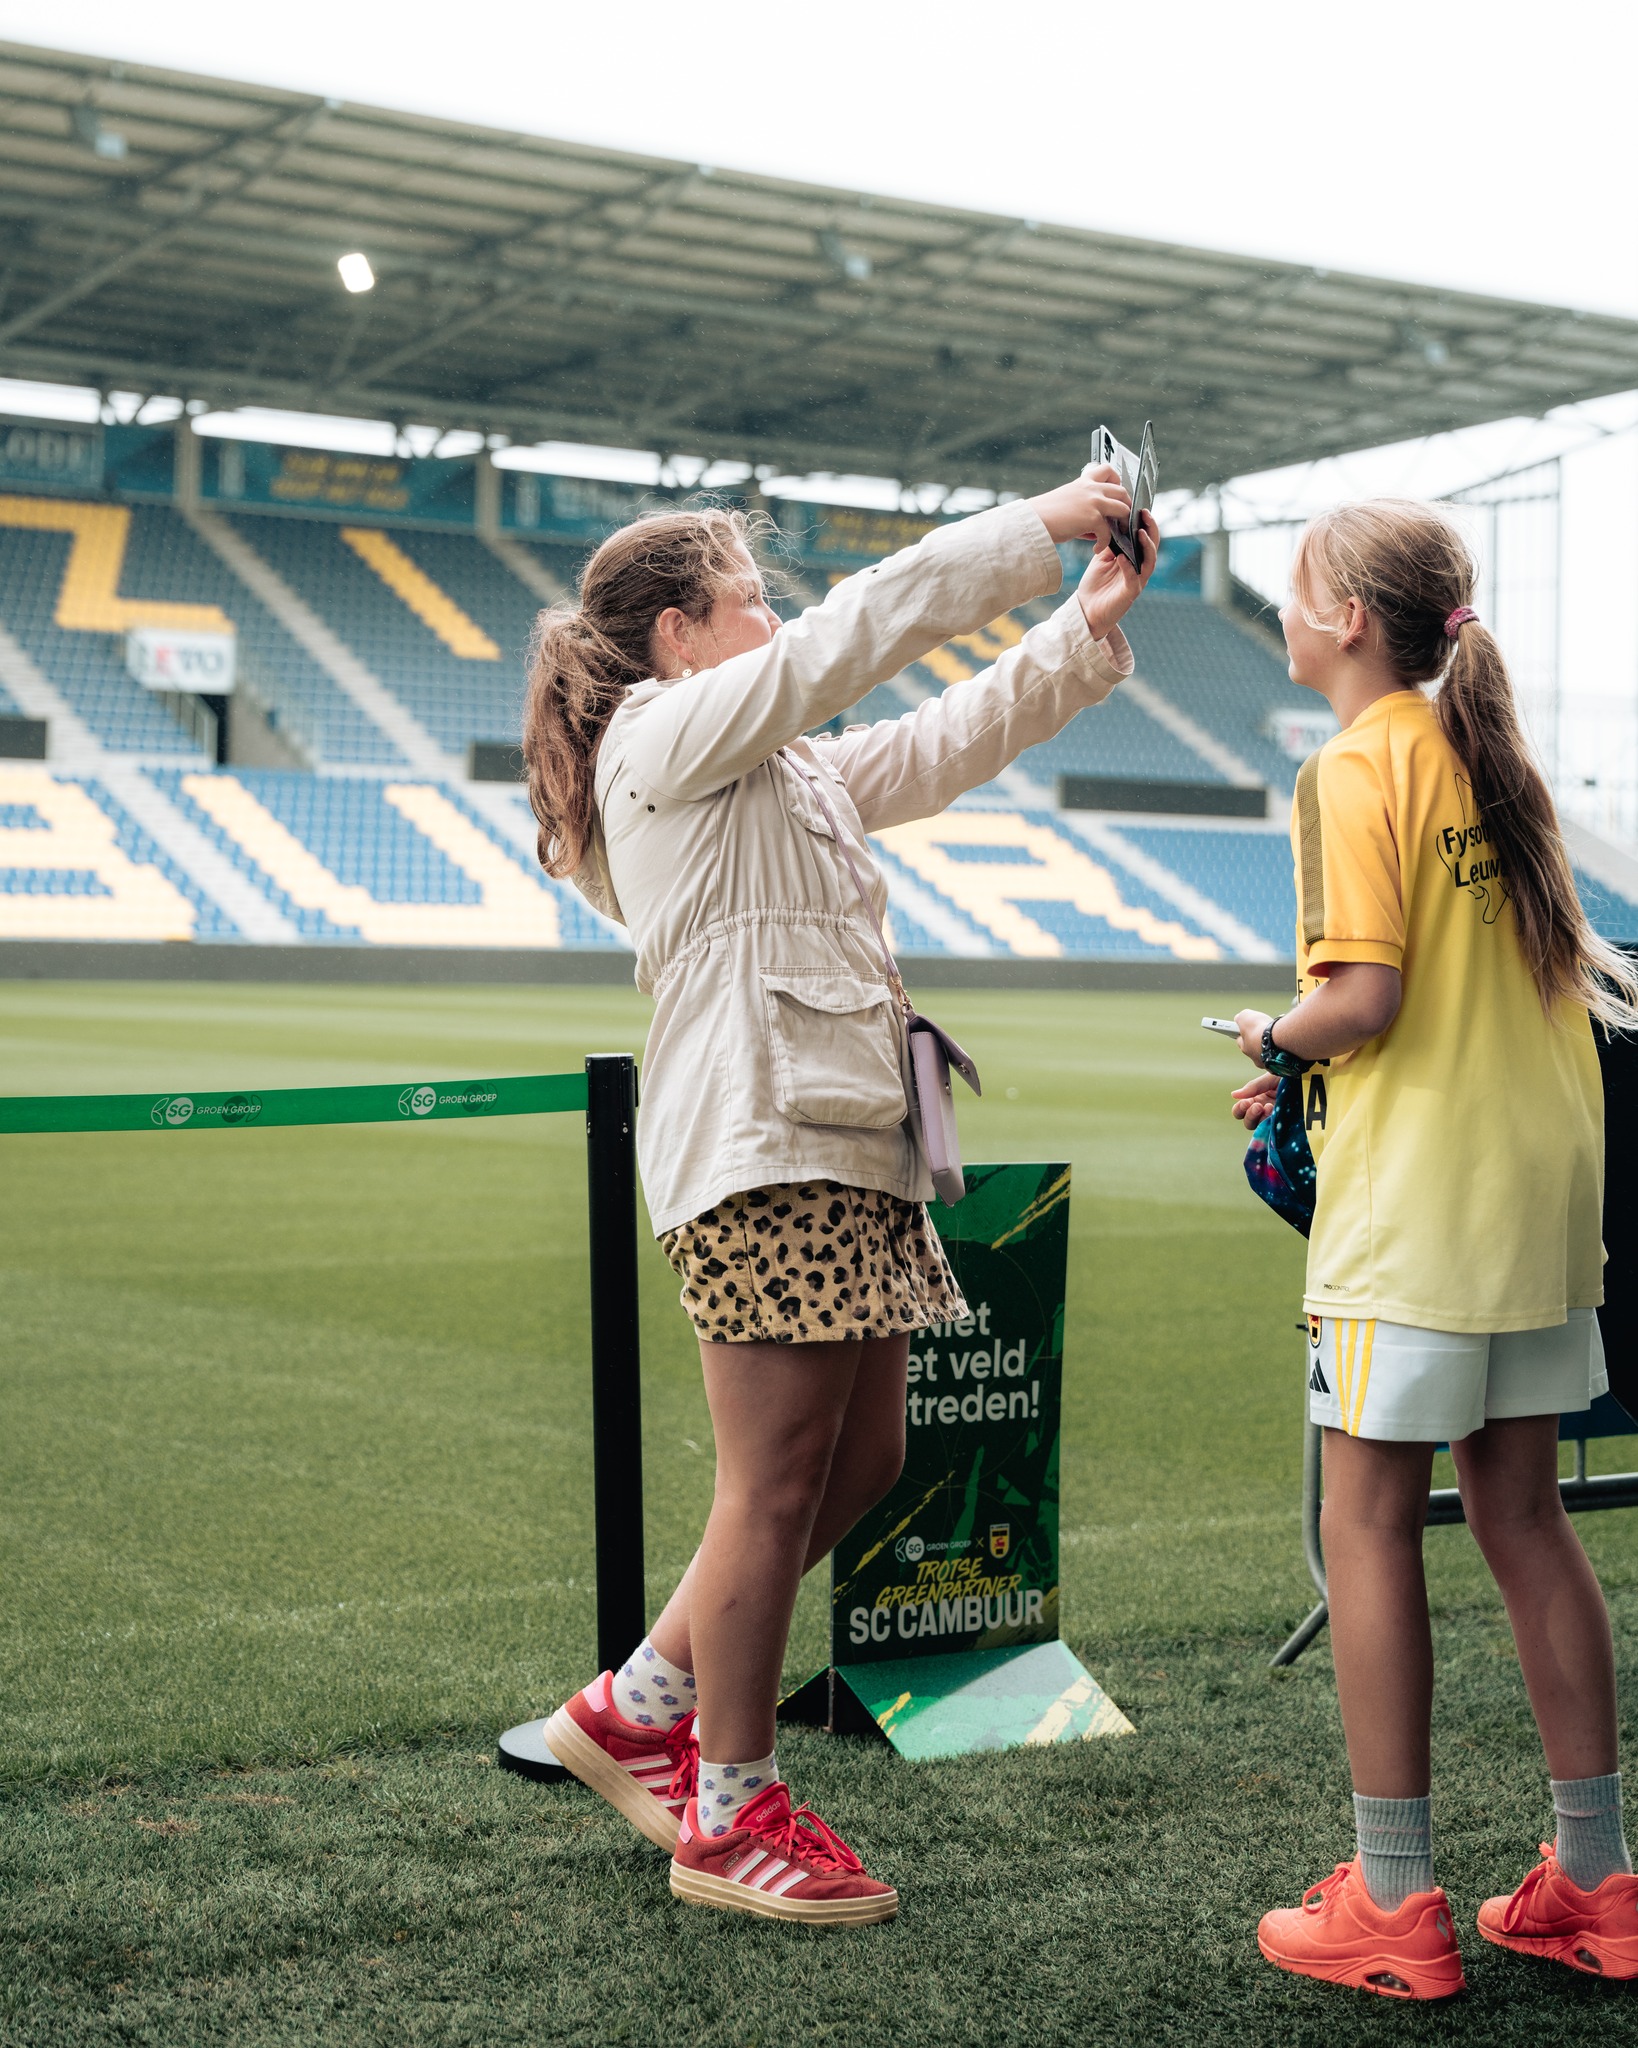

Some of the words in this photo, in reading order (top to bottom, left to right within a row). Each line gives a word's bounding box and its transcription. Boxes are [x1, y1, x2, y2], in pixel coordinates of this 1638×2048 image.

[167, 1103, 191, 1118] SG
[196, 1106, 228, 1115] GROEN
[230, 1105, 261, 1114] GROEP
[413, 1093, 434, 1108] SG
[438, 1095, 468, 1104] GROEN
[469, 1093, 497, 1103] GROEP
[907, 1346, 938, 1383] et
[949, 1338, 1026, 1380] veld
[906, 1380, 1040, 1426] treden!
[908, 1543, 922, 1554] SG
[926, 1542, 949, 1552] GROEN
[949, 1540, 972, 1549] GROEP
[916, 1557, 983, 1584] TROTSE
[875, 1574, 1022, 1609] GREENPARTNER
[849, 1606, 891, 1645] SC
[897, 1589, 1044, 1640] CAMBUUR
[756, 1801, 781, 1822] adidas
